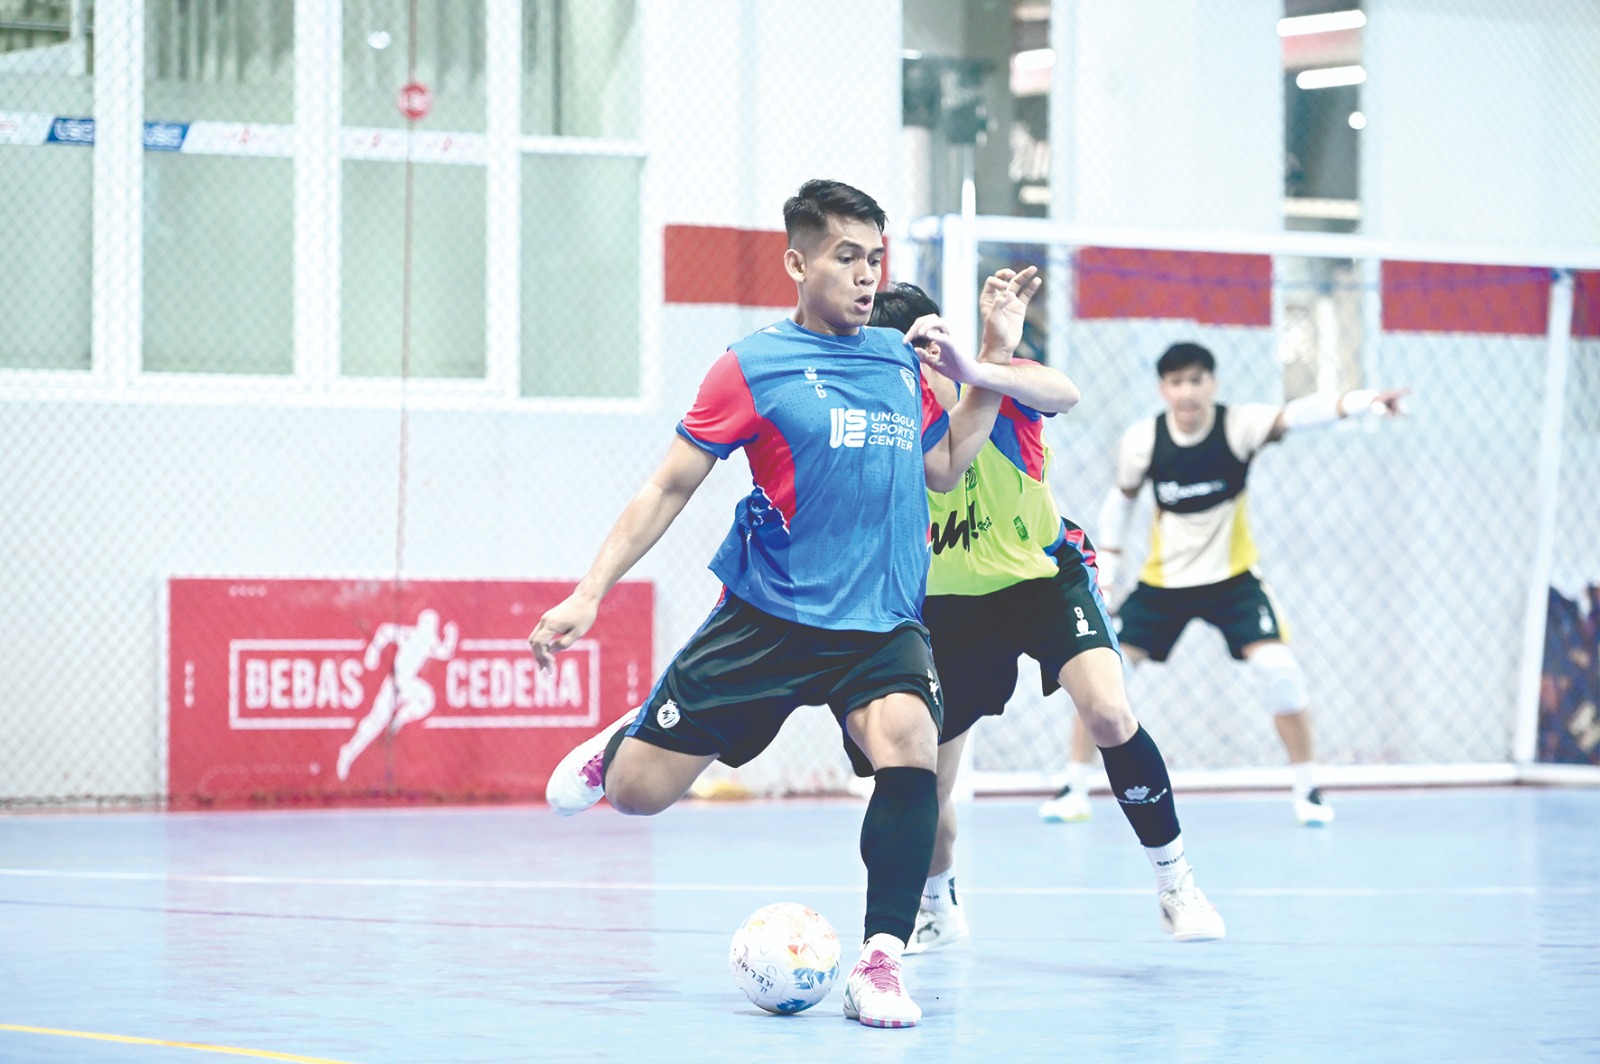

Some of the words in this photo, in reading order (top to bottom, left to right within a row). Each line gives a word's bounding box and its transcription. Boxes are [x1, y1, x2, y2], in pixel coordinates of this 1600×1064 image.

[870, 412, 918, 431] UNGGUL
[871, 423, 915, 440] SPORTS
[868, 434, 913, 452] CENTER
[245, 658, 365, 709] BEBAS
